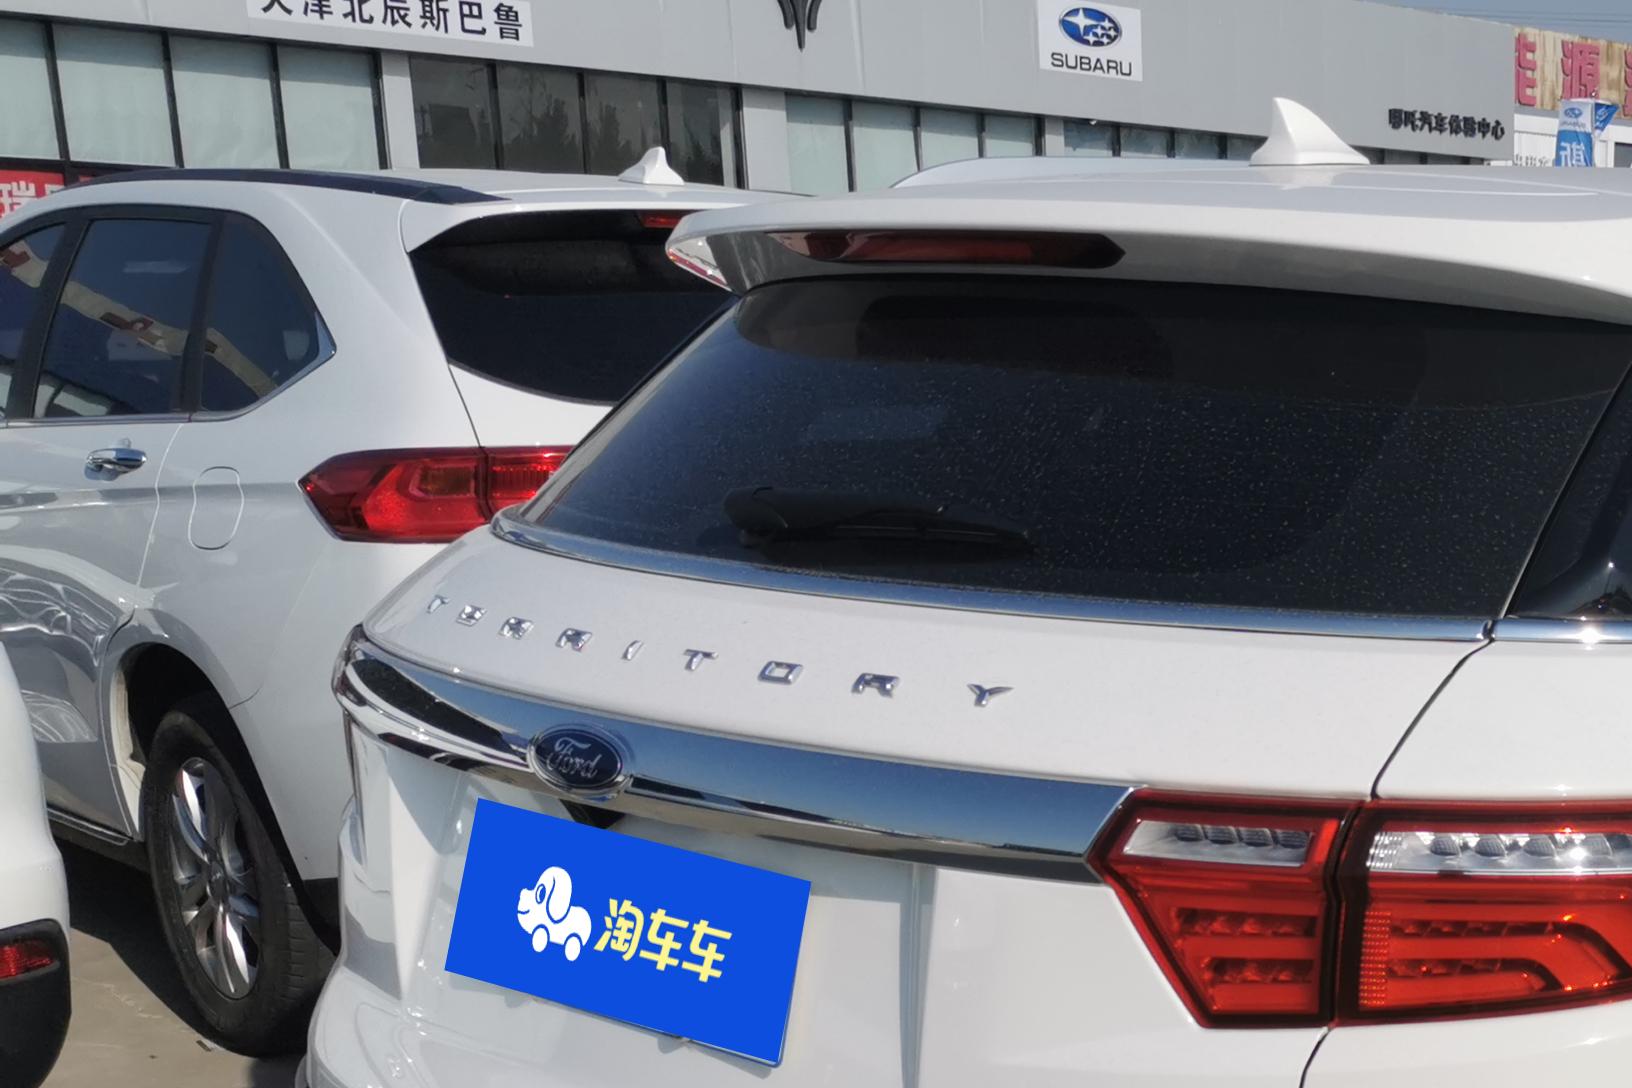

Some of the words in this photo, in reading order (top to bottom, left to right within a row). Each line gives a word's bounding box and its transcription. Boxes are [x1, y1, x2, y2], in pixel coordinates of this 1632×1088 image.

[1050, 52, 1132, 77] SUBARU
[427, 595, 1012, 707] TERRITORY
[547, 737, 602, 777] Ford
